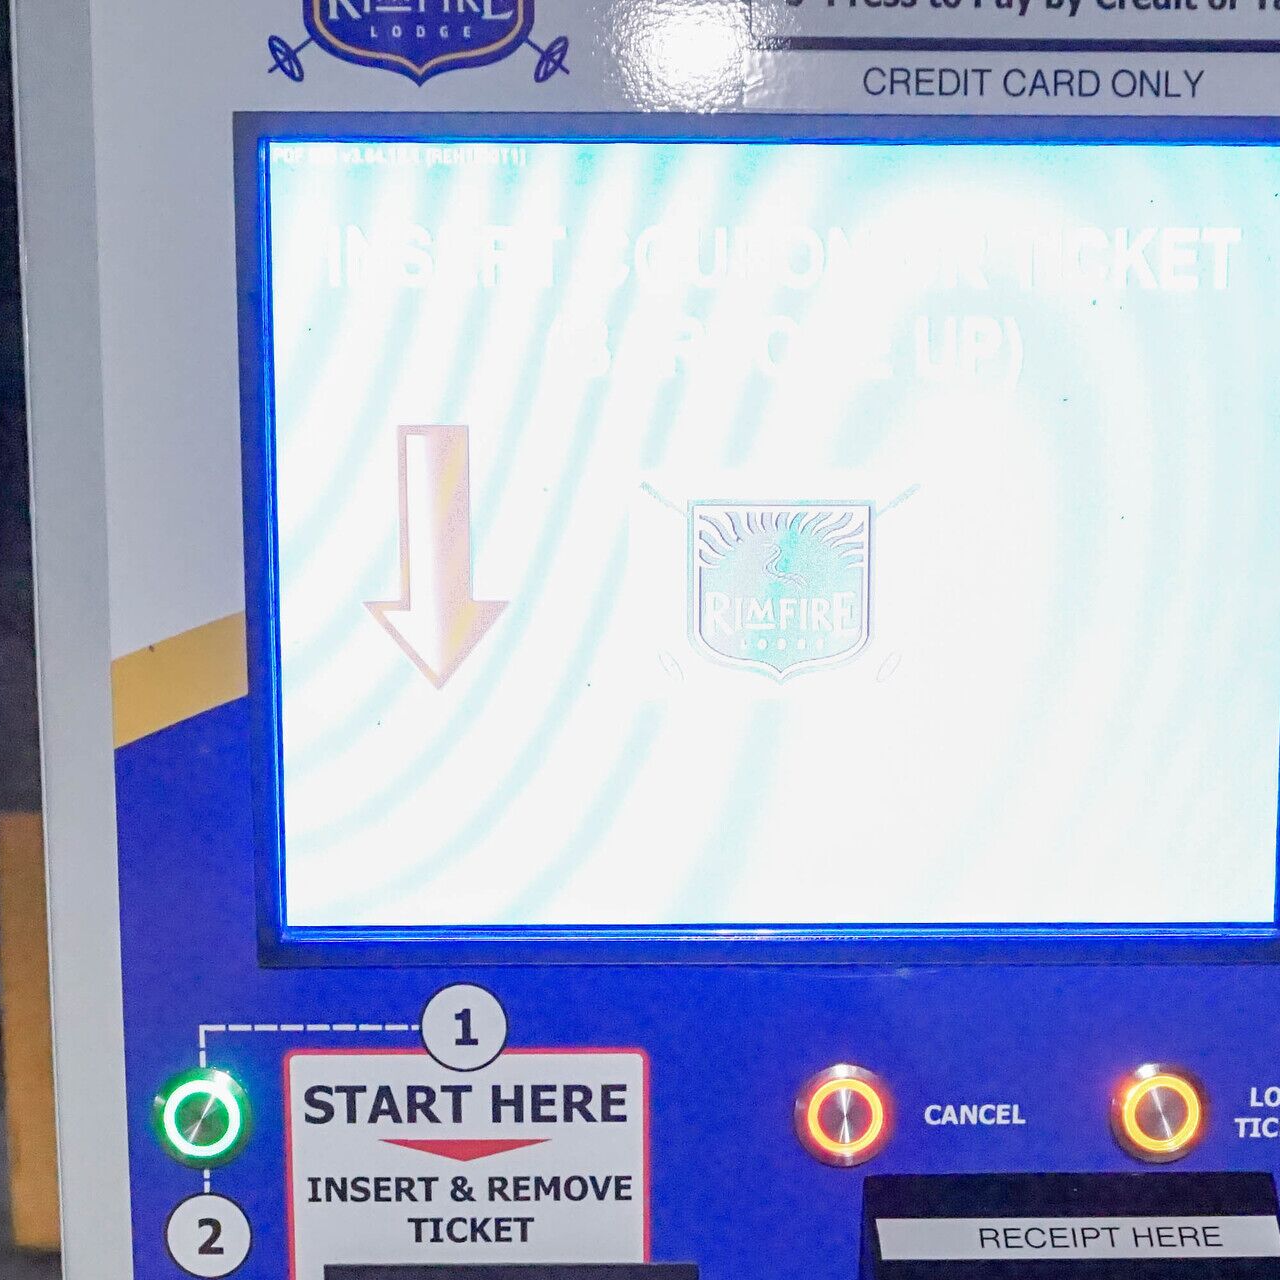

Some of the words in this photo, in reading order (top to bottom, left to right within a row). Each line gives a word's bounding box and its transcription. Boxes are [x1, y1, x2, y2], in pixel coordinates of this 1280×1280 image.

[371, 25, 470, 38] LODGE
[863, 67, 992, 96] CREDIT
[1003, 68, 1100, 97] CARD
[1111, 69, 1204, 98] ONLY
[318, 224, 567, 287] INSRT
[1012, 227, 1242, 290] TICKET
[705, 590, 859, 634] RIMFIRE
[455, 1008, 478, 1045] 1
[304, 1085, 472, 1124] START
[492, 1084, 627, 1123] HERE
[924, 1104, 1026, 1125] CANCEL
[308, 1176, 439, 1202] INSERT
[450, 1176, 476, 1202] &
[488, 1175, 632, 1201] REMOVE
[198, 1218, 224, 1255] 2
[407, 1217, 534, 1243] TICKET
[979, 1227, 1120, 1249] RECEIPT
[1132, 1226, 1223, 1247] HERE
